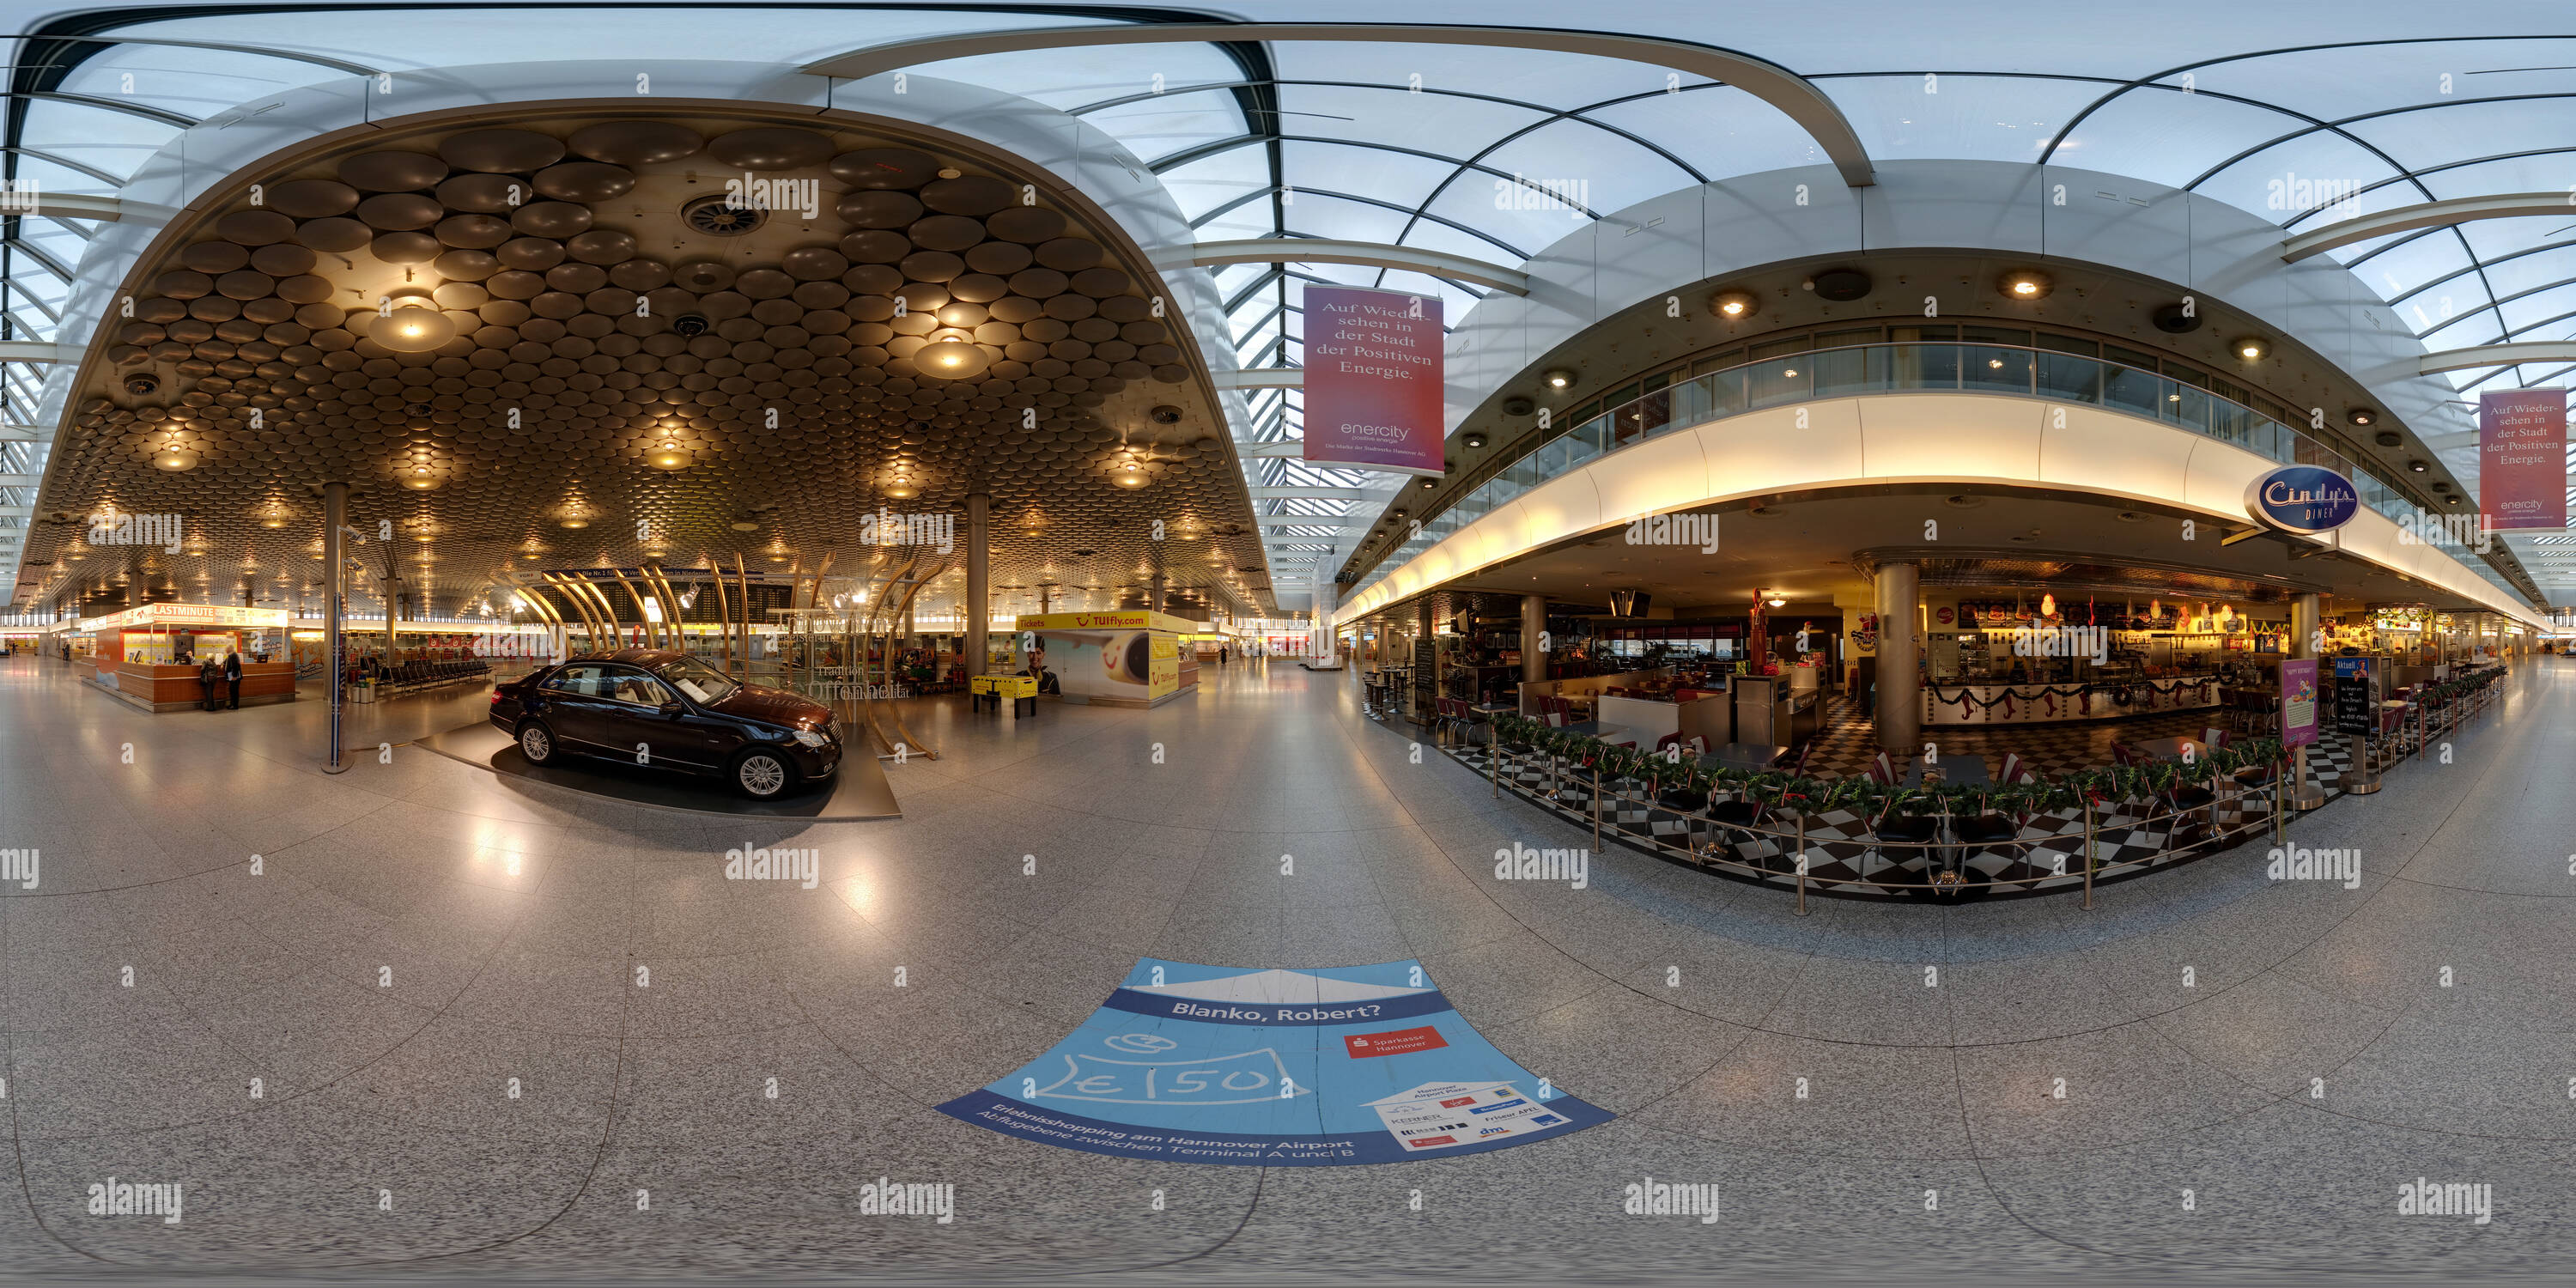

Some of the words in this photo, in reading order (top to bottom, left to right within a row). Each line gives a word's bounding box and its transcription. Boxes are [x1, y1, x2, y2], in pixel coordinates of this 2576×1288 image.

[1322, 303, 1358, 314] Auf
[1338, 317, 1388, 329] sehen
[1396, 321, 1412, 332] in
[1335, 330, 1364, 341] der
[1371, 332, 1416, 347] Stadt
[1316, 344, 1347, 355] der
[1353, 347, 1432, 366] Positiven
[1340, 361, 1413, 380] Energie.
[2490, 405, 2512, 416] Auf
[2514, 404, 2559, 413] Wieder-
[2500, 416, 2530, 425] sehen
[2535, 416, 2545, 424] in
[1340, 423, 1409, 441] enercity
[2497, 430, 2516, 439] der
[2518, 428, 2548, 437] Stadt
[2487, 443, 2505, 453] der
[2508, 441, 2559, 451] Positiven
[2500, 455, 2546, 465] Energie.
[2265, 481, 2354, 510] Cindy's
[2500, 500, 2543, 510] enercity
[2306, 507, 2333, 521] DINER
[154, 605, 214, 617] LASTMINUTE
[1020, 618, 1045, 628] Tickets
[1093, 616, 1144, 628] TUIfly.com
[2336, 659, 2355, 669] Aktuell
[817, 665, 865, 676] Tradition
[1172, 1002, 1268, 1023] Blanko,
[1277, 1004, 1382, 1022] Robert?
[1373, 1035, 1425, 1046] Sparkasse
[1376, 1041, 1427, 1052] Hannover
[1485, 1111, 1515, 1122] Friseur
[990, 1103, 1127, 1140] Erlebnisshopping
[1130, 1130, 1163, 1142] am
[1168, 1135, 1272, 1150] Hannover
[1275, 1139, 1355, 1151] Airport
[1479, 1126, 1504, 1135] dm
[975, 1109, 1073, 1140] Abflugebene
[1078, 1136, 1163, 1151] zwischen
[1171, 1145, 1261, 1157] Terminal
[1291, 1149, 1334, 1158] und
[1342, 1149, 1356, 1157] B
